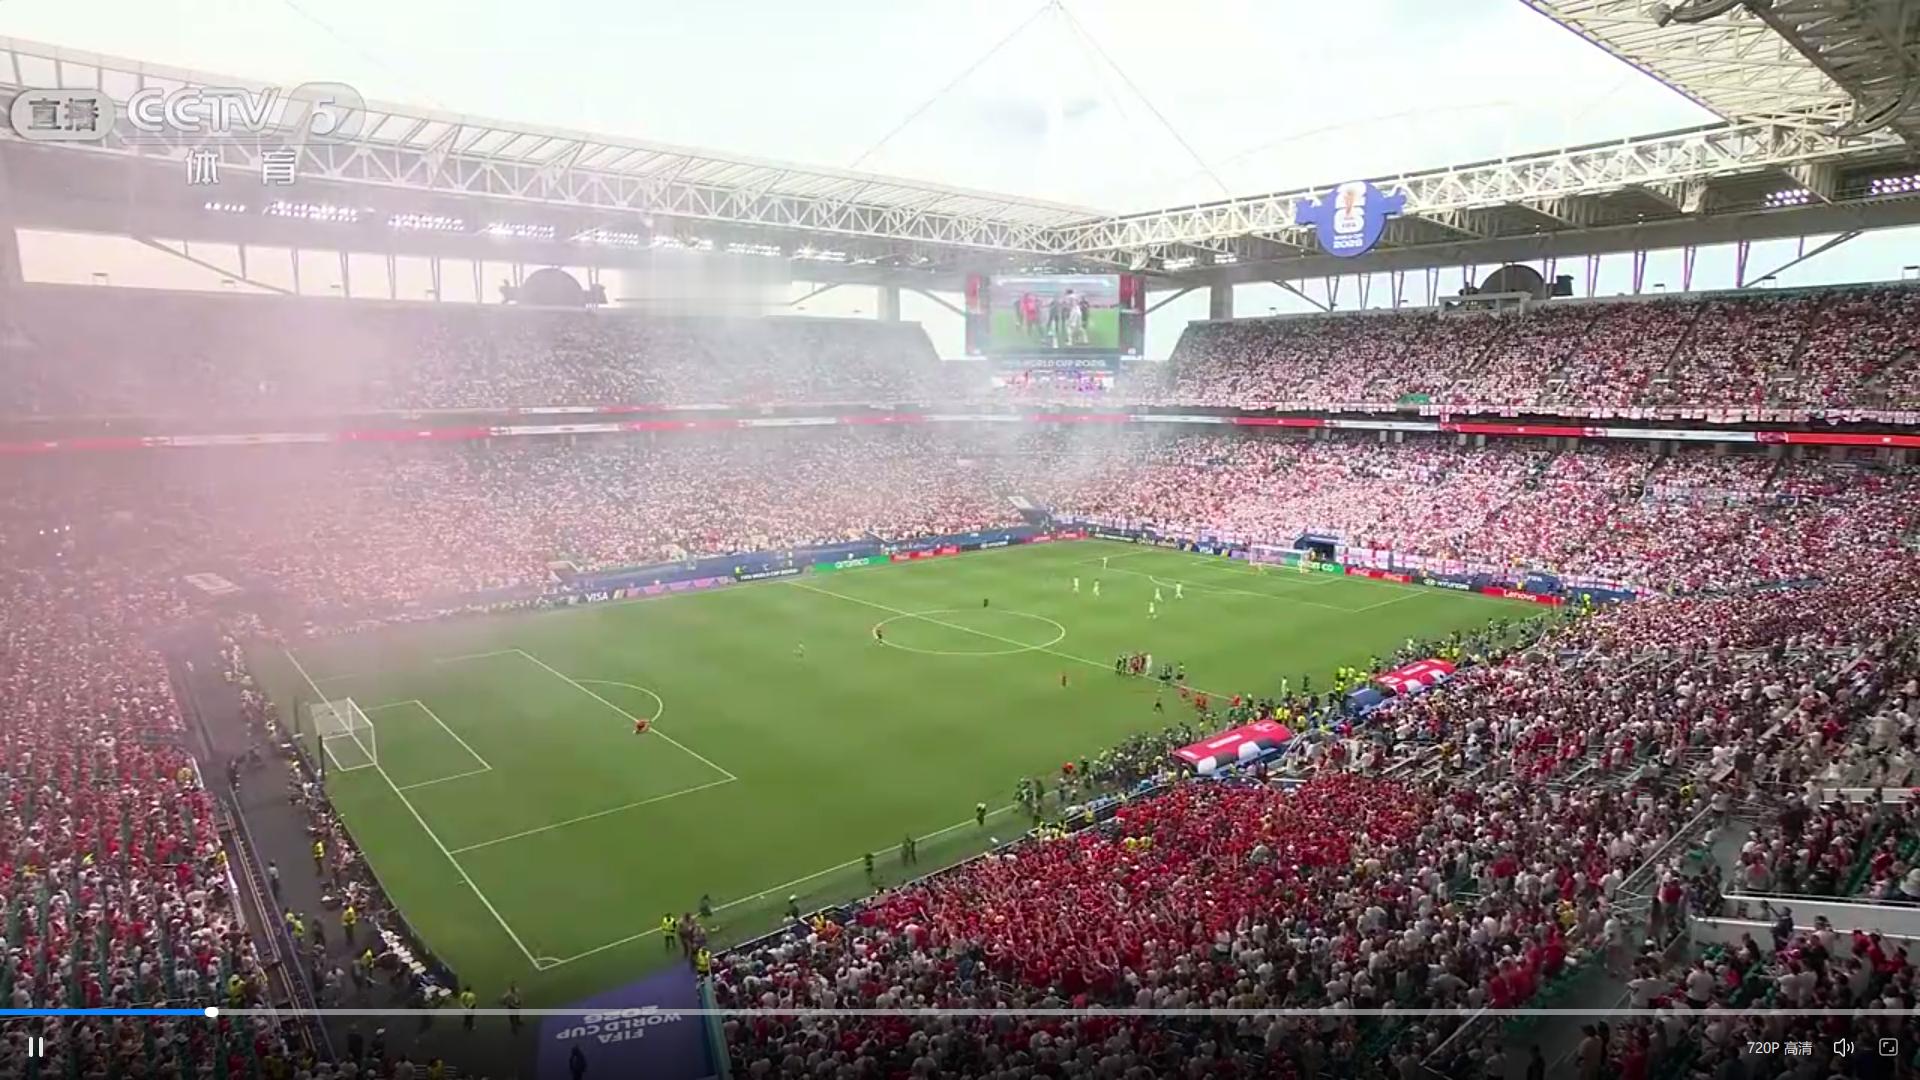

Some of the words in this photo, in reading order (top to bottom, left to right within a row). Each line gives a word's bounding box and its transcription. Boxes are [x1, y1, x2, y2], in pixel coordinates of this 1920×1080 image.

[1055, 359, 1074, 368] CUP
[834, 558, 869, 569] aramco
[584, 591, 609, 603] VISA
[1503, 589, 1537, 602] Lenovo
[584, 1005, 659, 1024] 2026
[604, 1012, 682, 1031] WORLD
[555, 1025, 600, 1040] CUP
[598, 1028, 644, 1043] FIFA
